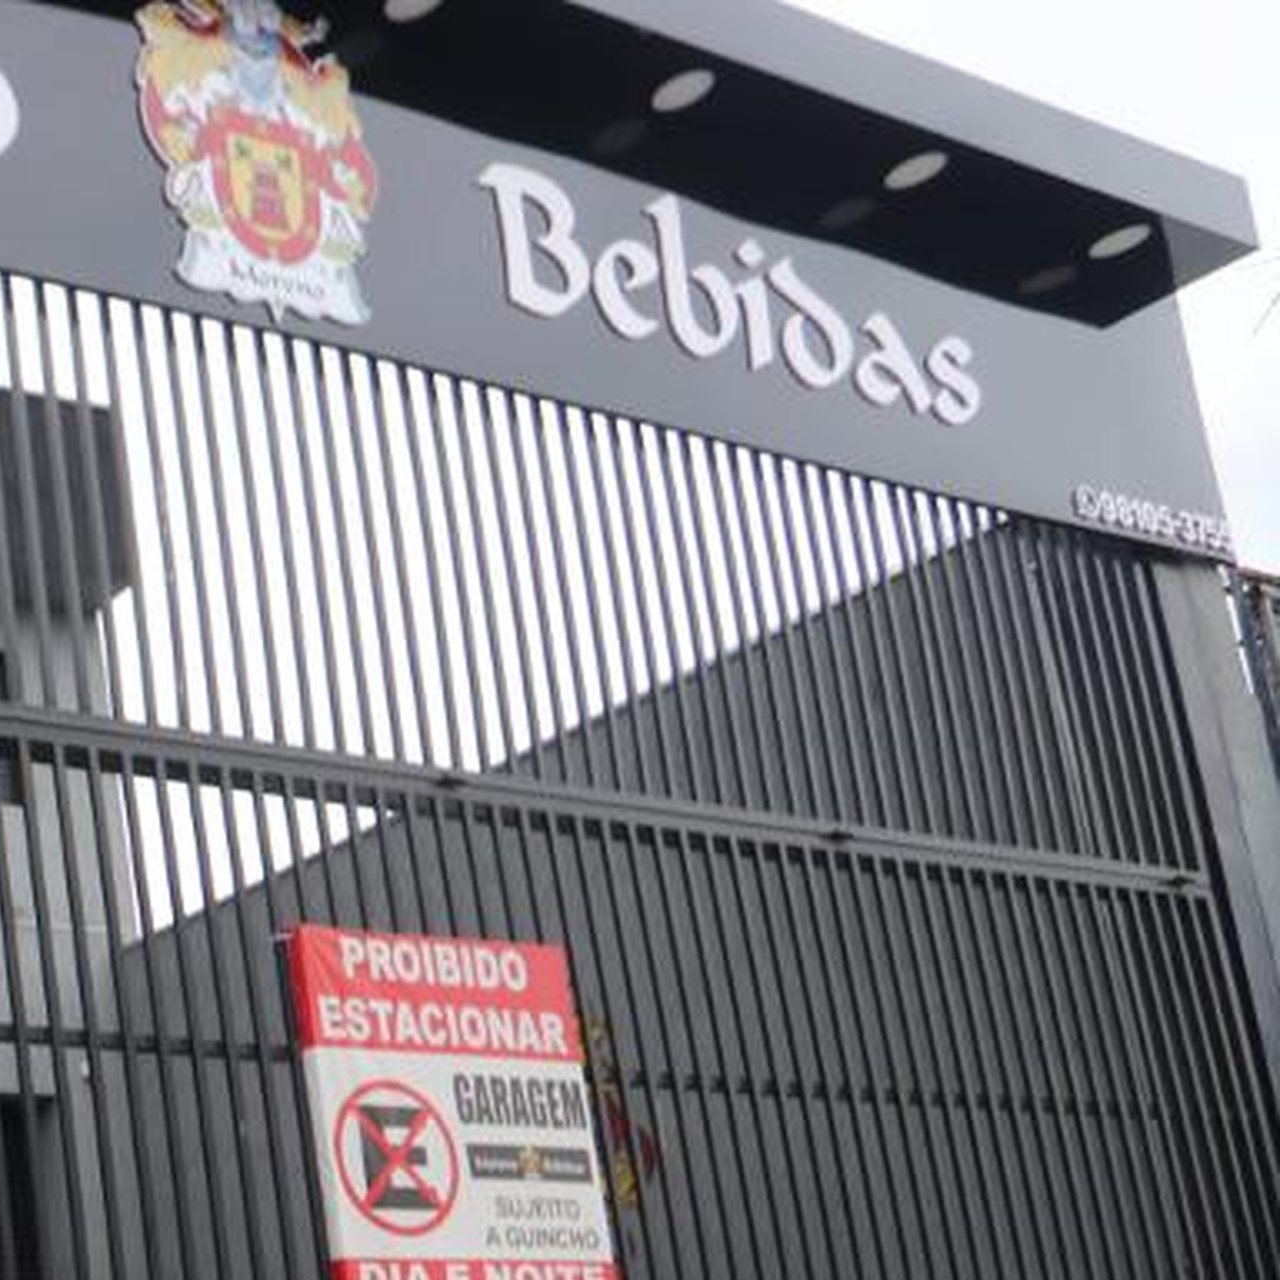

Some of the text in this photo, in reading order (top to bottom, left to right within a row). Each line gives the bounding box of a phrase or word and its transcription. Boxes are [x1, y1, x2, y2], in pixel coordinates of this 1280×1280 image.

[477, 162, 981, 427] Bebidas
[340, 936, 528, 990] PROIBIDO
[317, 995, 568, 1053] ESTACIONAR
[454, 1073, 587, 1129] GARAGEM
